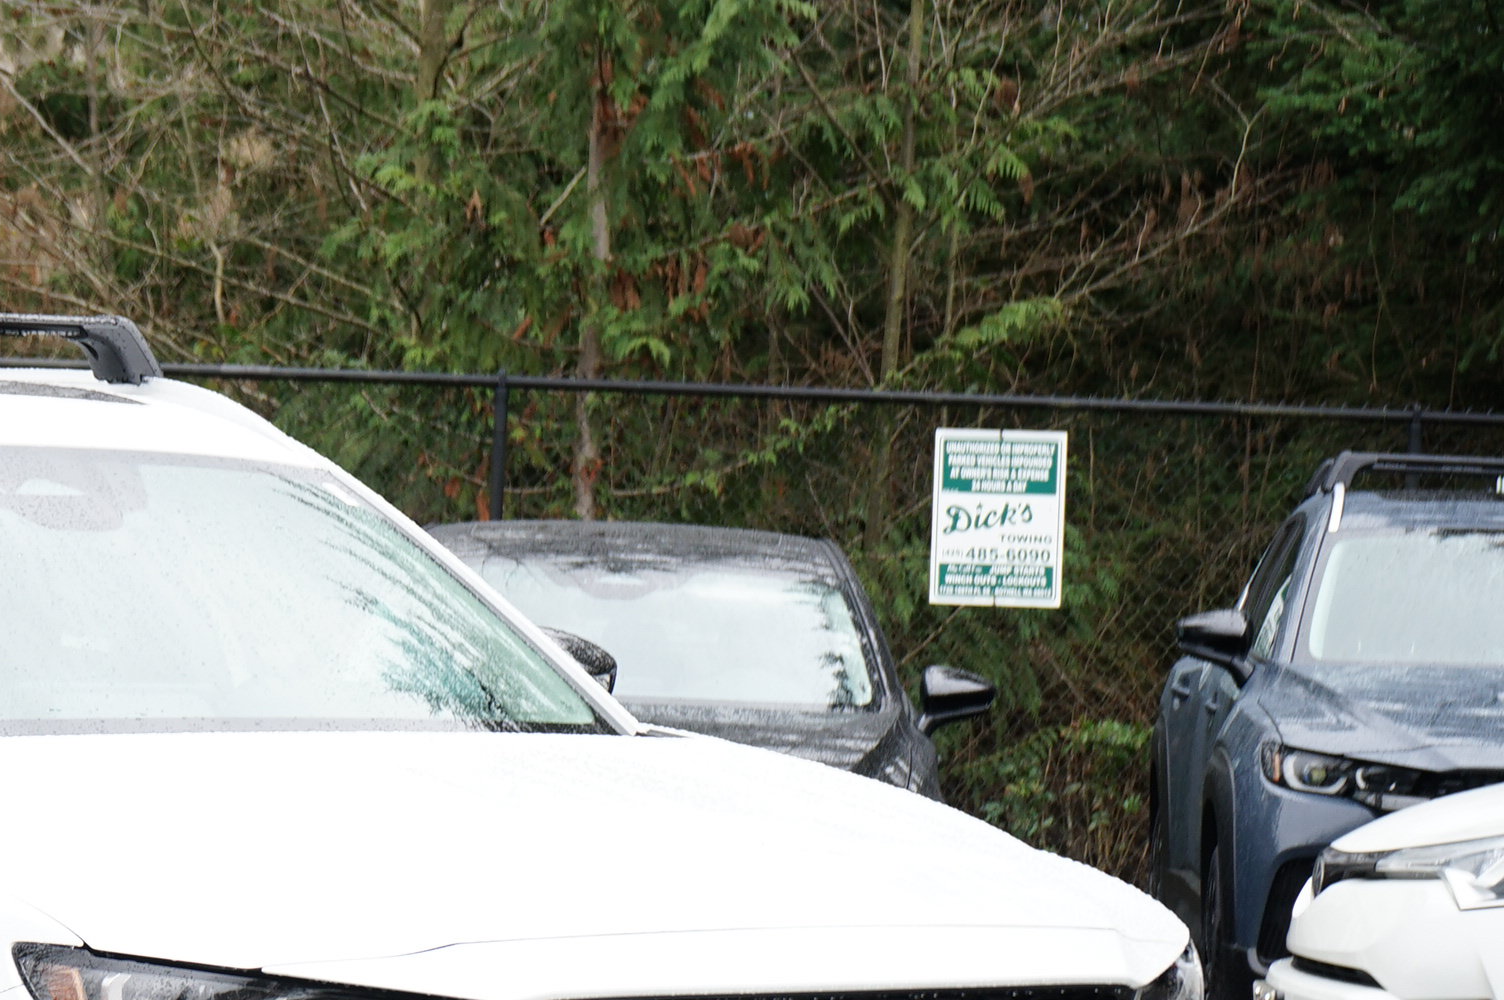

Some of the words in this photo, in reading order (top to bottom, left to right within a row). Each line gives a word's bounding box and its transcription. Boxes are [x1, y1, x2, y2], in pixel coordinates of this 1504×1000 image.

[943, 501, 1033, 535] Dick's
[1001, 534, 1052, 545] TOWING
[965, 547, 1051, 562] 485-6090
